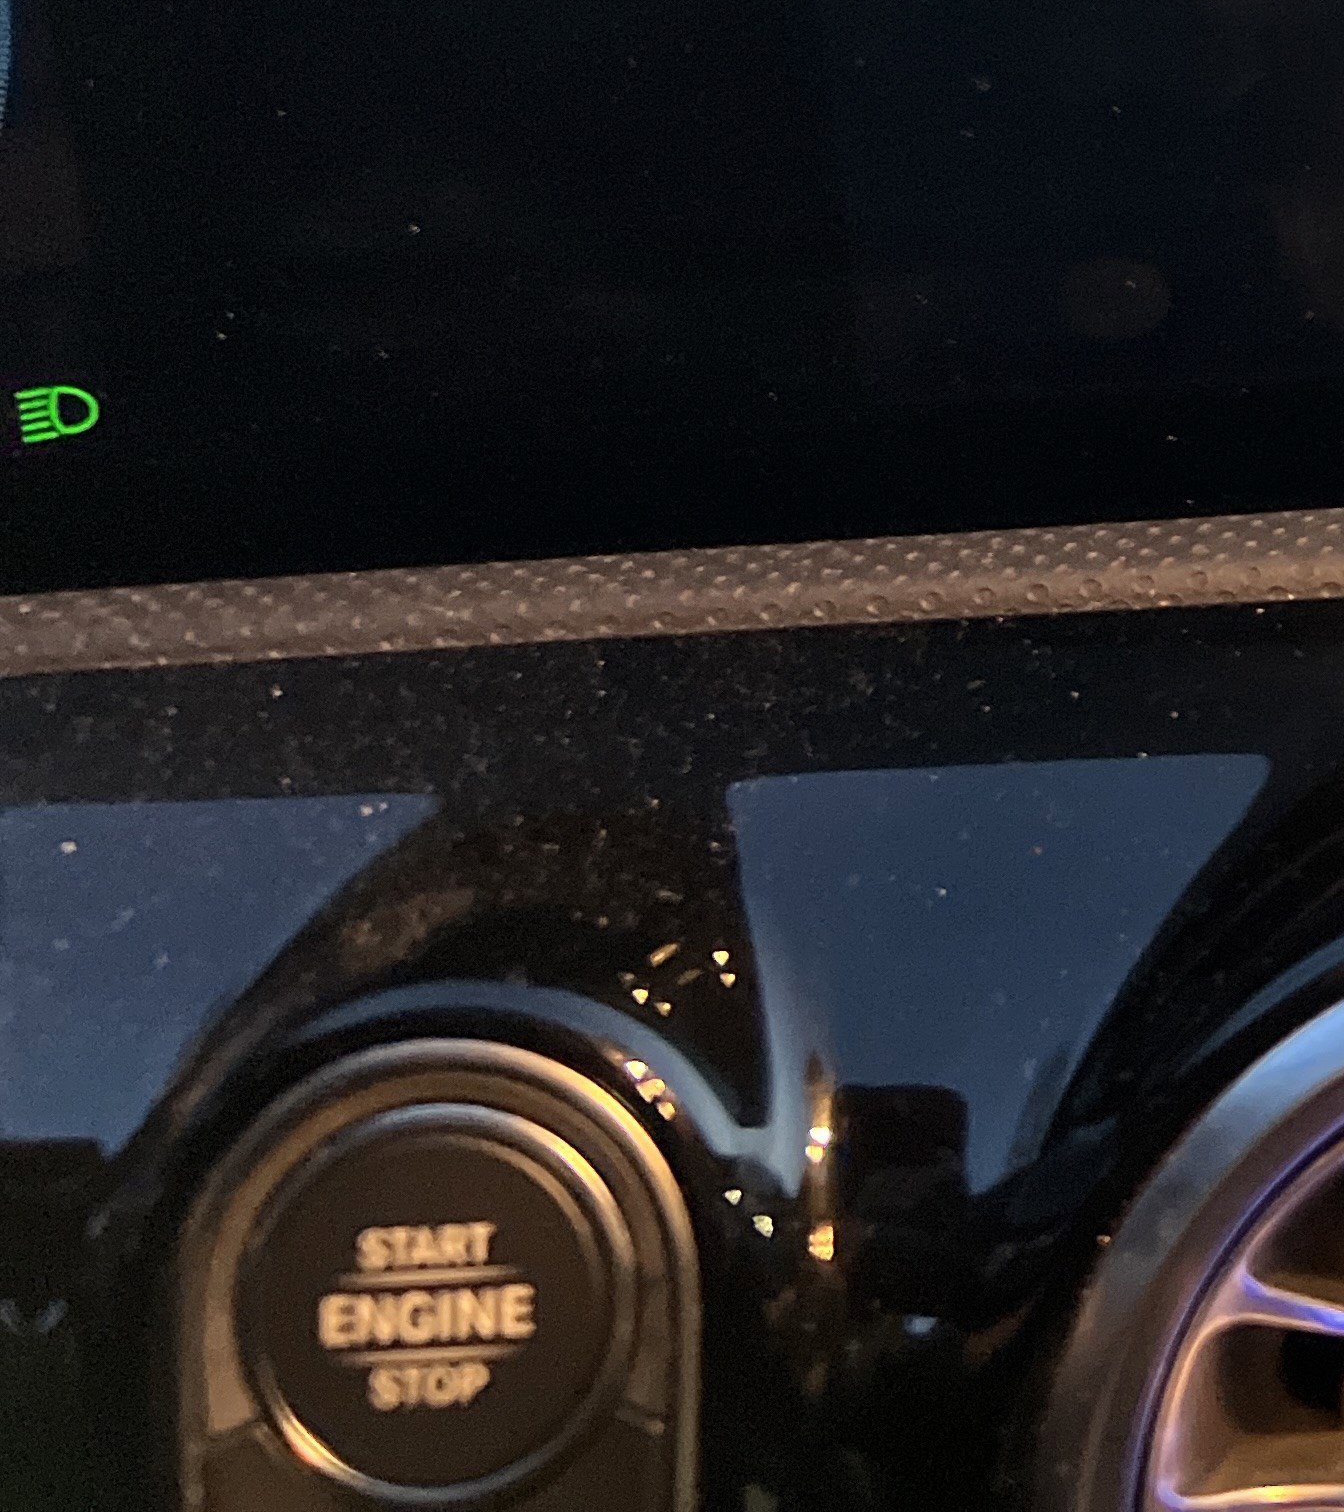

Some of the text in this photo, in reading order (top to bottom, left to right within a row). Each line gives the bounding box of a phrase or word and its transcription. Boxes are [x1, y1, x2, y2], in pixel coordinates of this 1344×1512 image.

[356, 1221, 497, 1271] START
[318, 1283, 537, 1349] ENGINE
[368, 1361, 491, 1412] STOP
